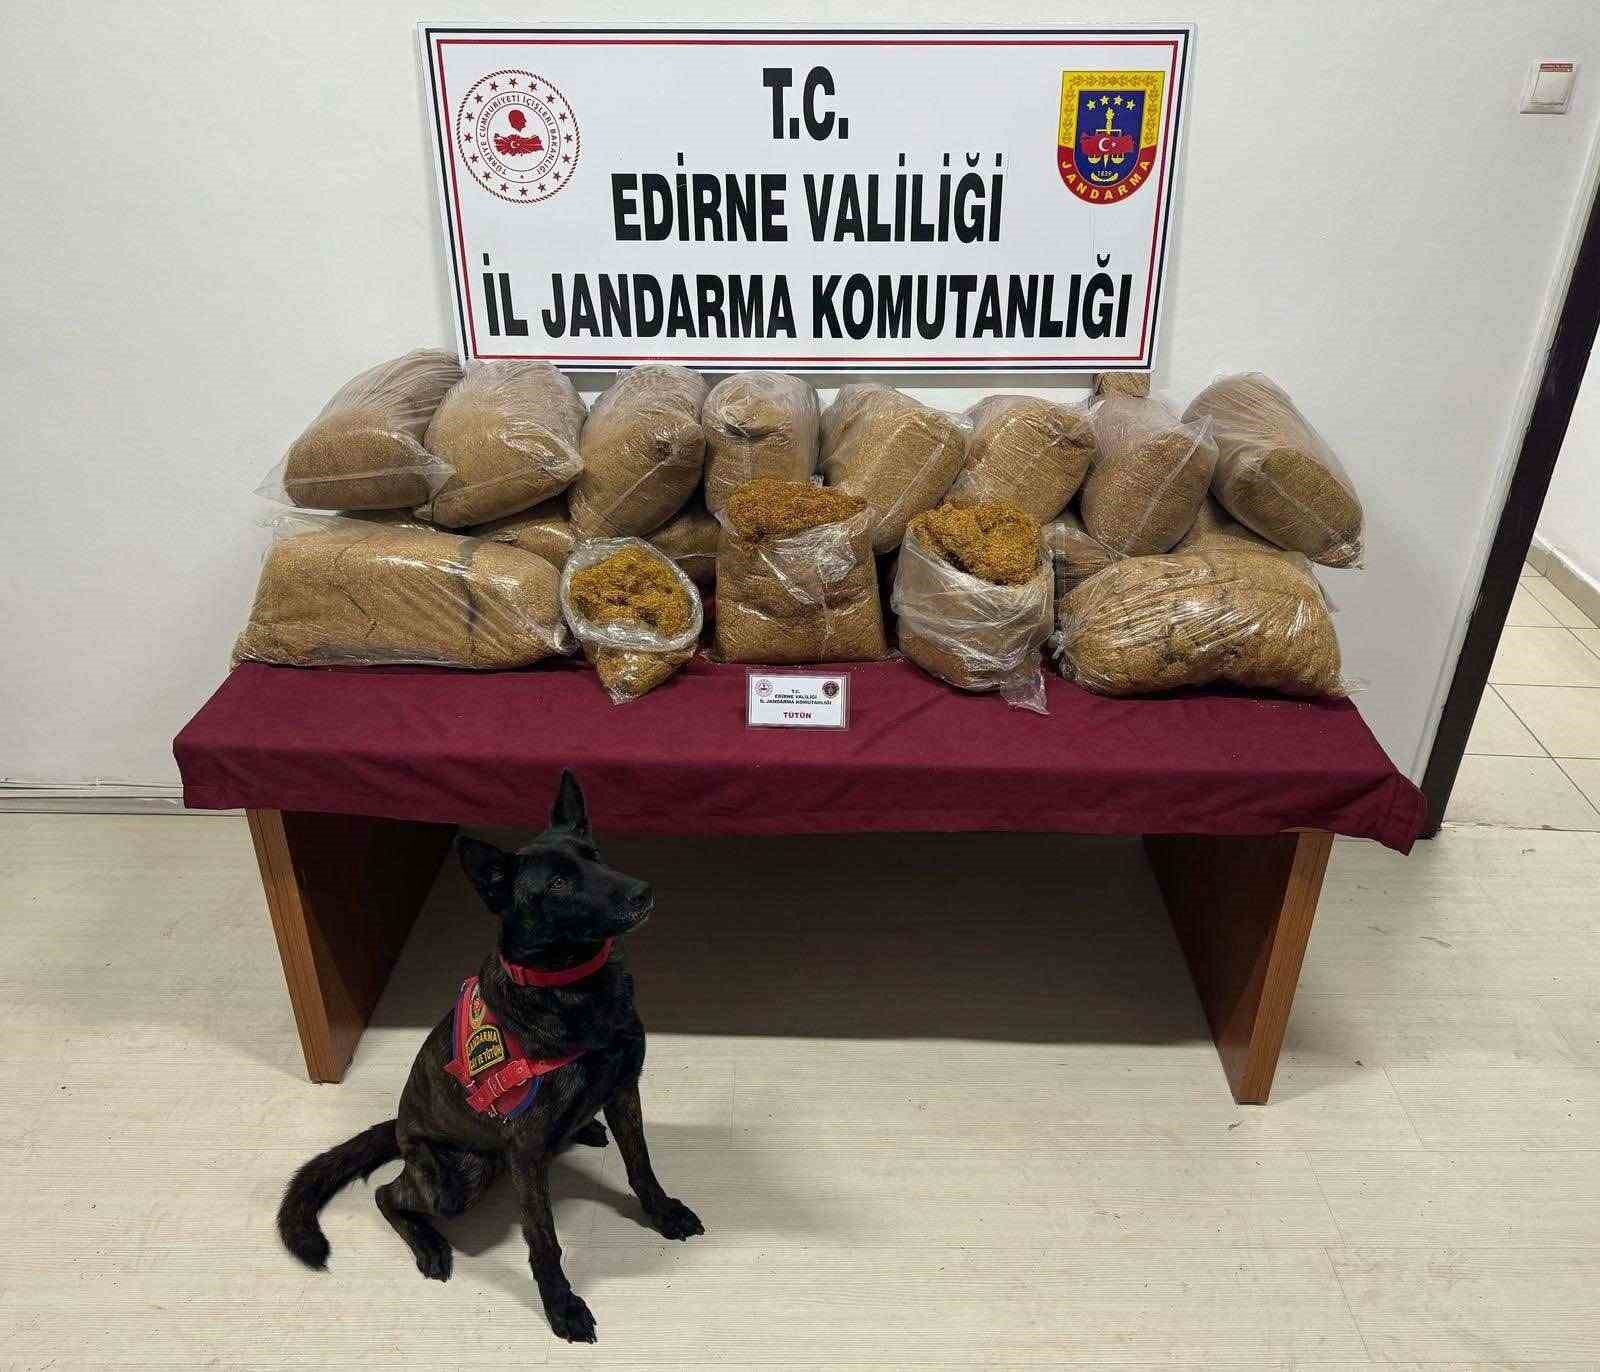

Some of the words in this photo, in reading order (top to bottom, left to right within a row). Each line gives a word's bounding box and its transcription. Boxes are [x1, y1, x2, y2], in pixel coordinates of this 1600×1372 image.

[762, 65, 850, 140] T.C.
[610, 153, 788, 243] EDİRNE
[802, 153, 1005, 243] VALİLİĞİ
[1062, 161, 1151, 201] JANDARMA
[482, 253, 529, 337] İL
[541, 273, 797, 340] JANDARMA
[811, 253, 1133, 340] KOMUTANLIĞI
[783, 711, 812, 719] TÜTÜN
